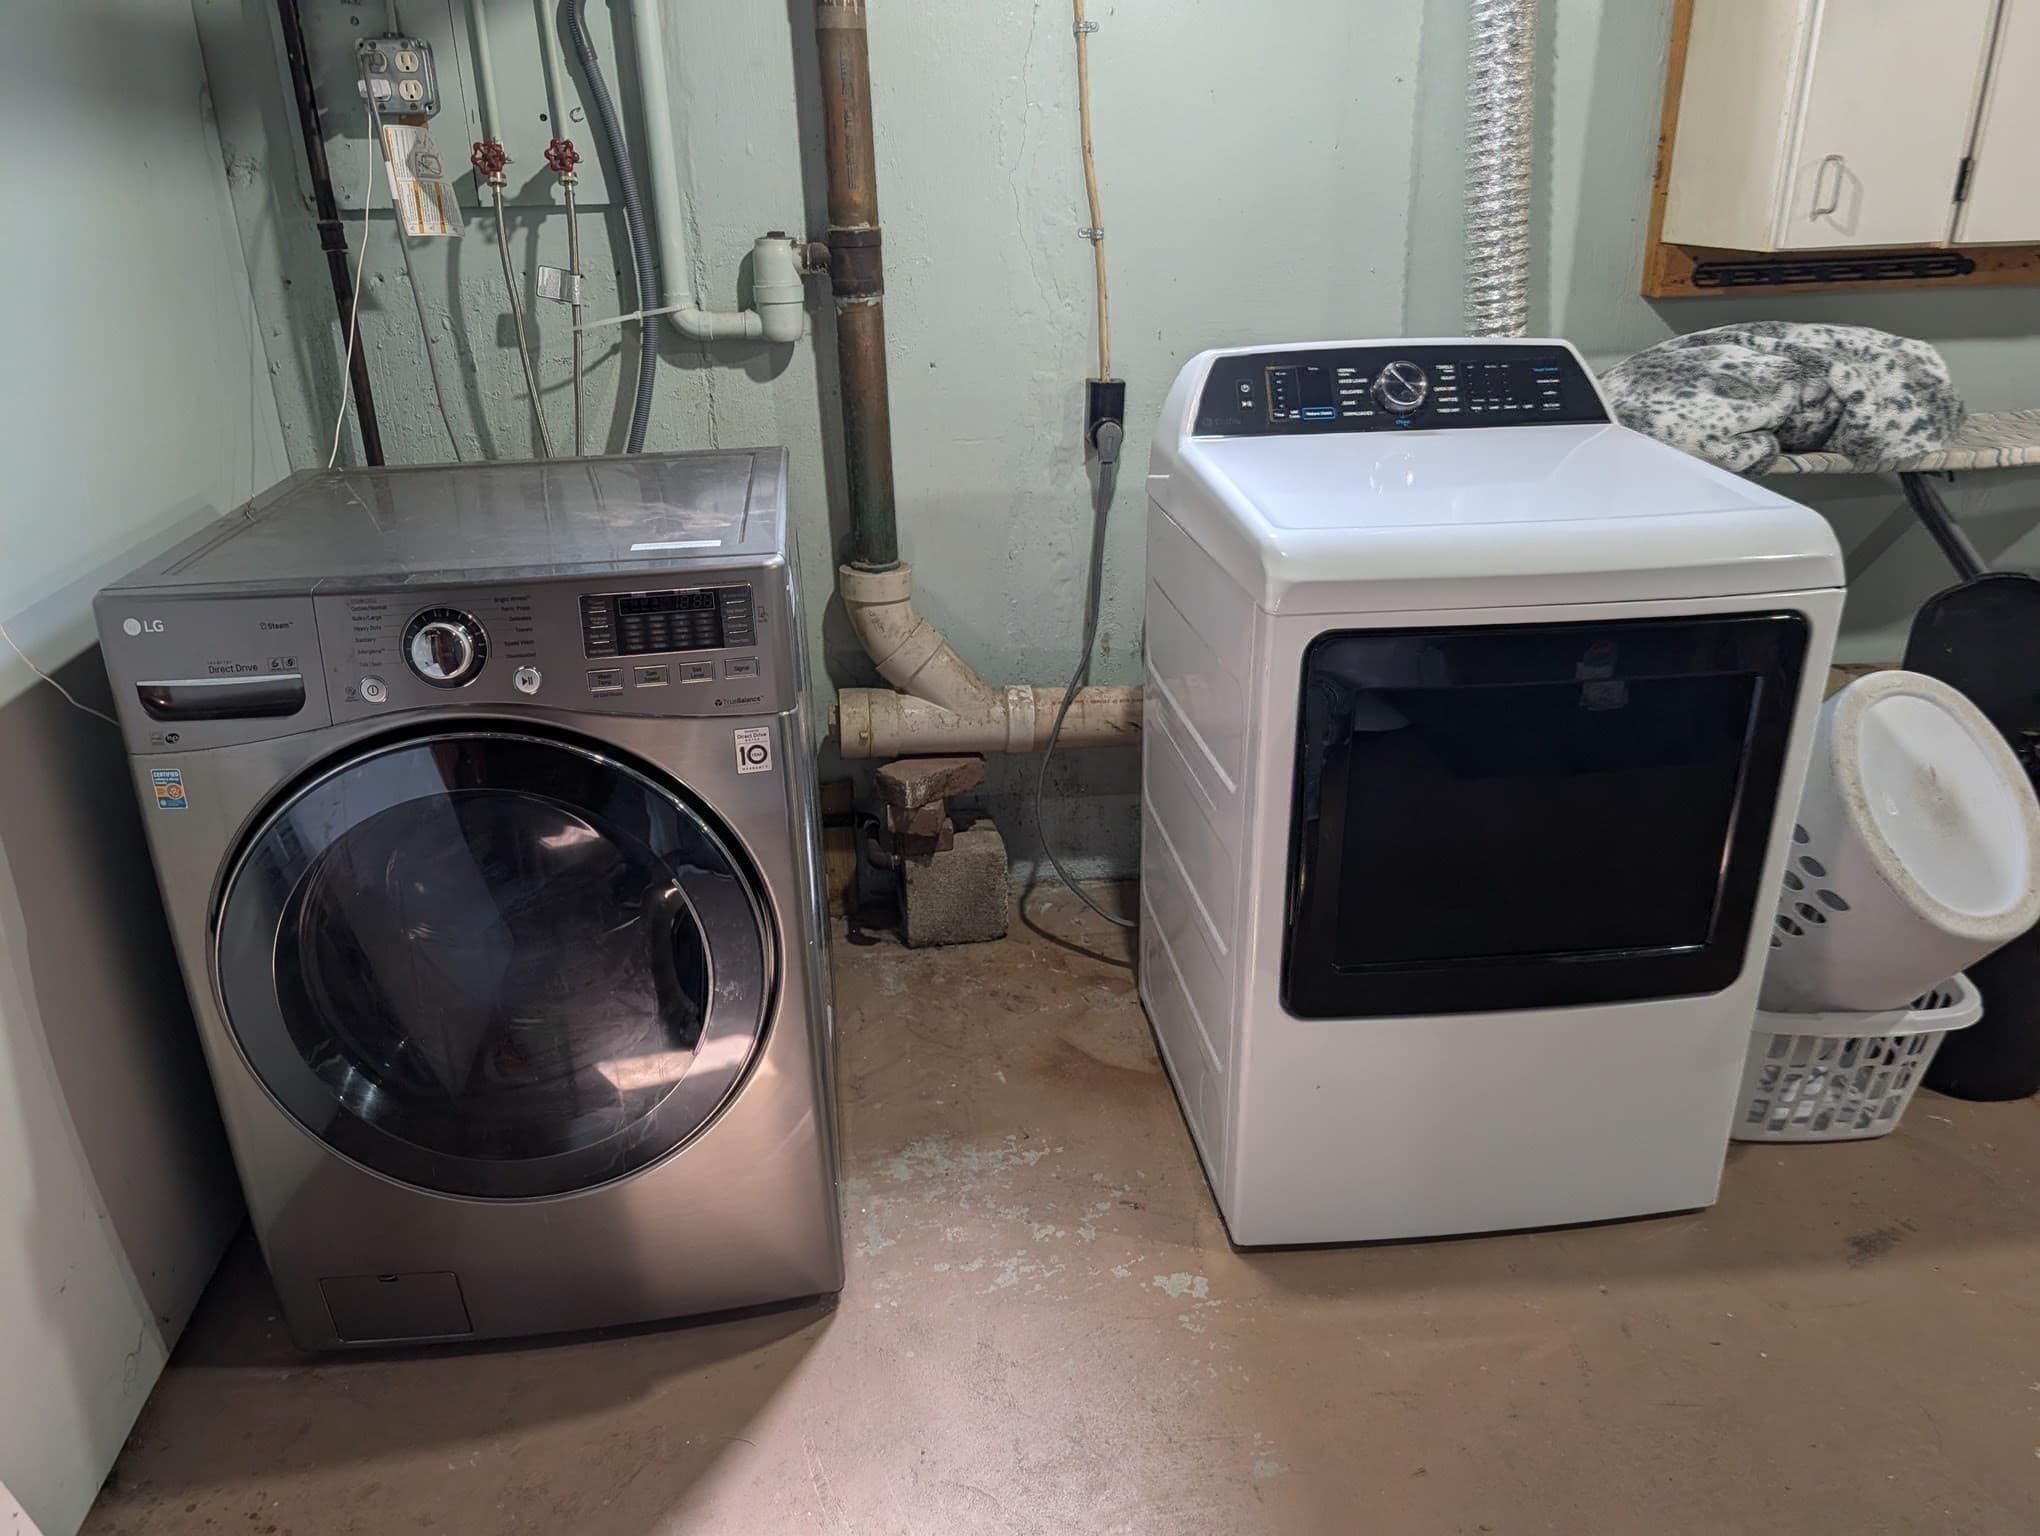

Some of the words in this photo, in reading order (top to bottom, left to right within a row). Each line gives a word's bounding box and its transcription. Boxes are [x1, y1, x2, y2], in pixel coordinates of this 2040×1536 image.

[144, 619, 165, 633] LG
[207, 664, 234, 674] Direct
[235, 663, 258, 672] Drive
[739, 744, 768, 766] 10
